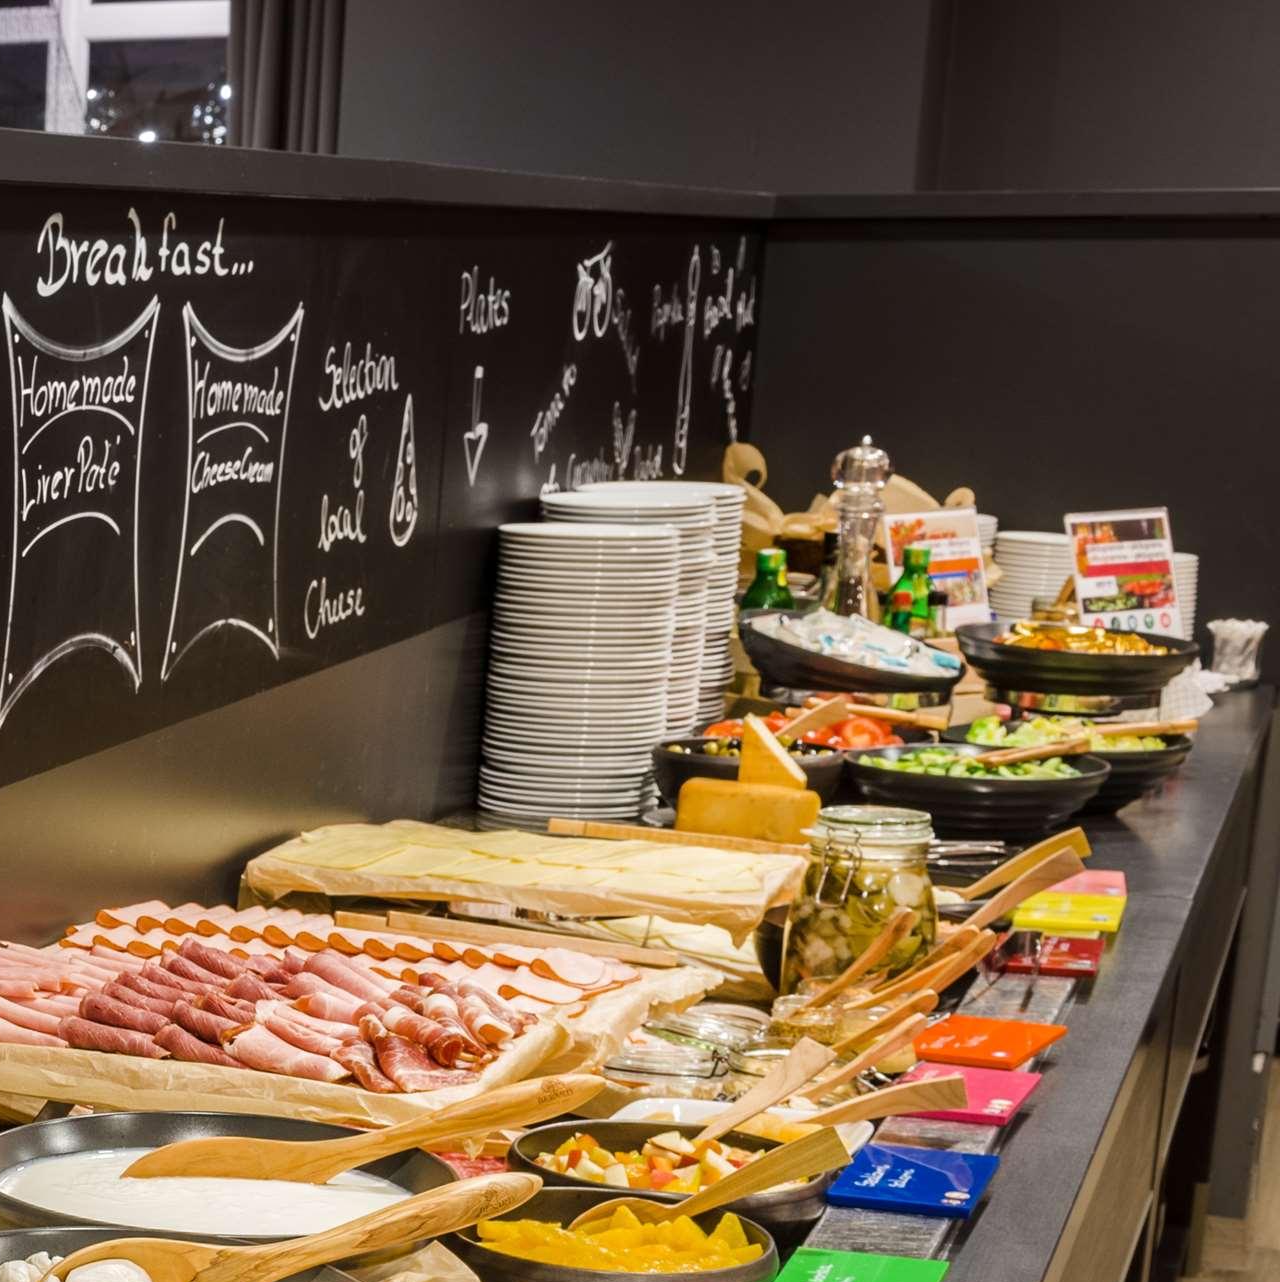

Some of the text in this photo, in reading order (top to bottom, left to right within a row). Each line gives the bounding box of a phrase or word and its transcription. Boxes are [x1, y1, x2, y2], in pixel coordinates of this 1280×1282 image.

[458, 264, 512, 335] Plates
[318, 341, 400, 412] Selection
[349, 414, 369, 489] of
[20, 462, 76, 522] Liver
[318, 489, 367, 553] local
